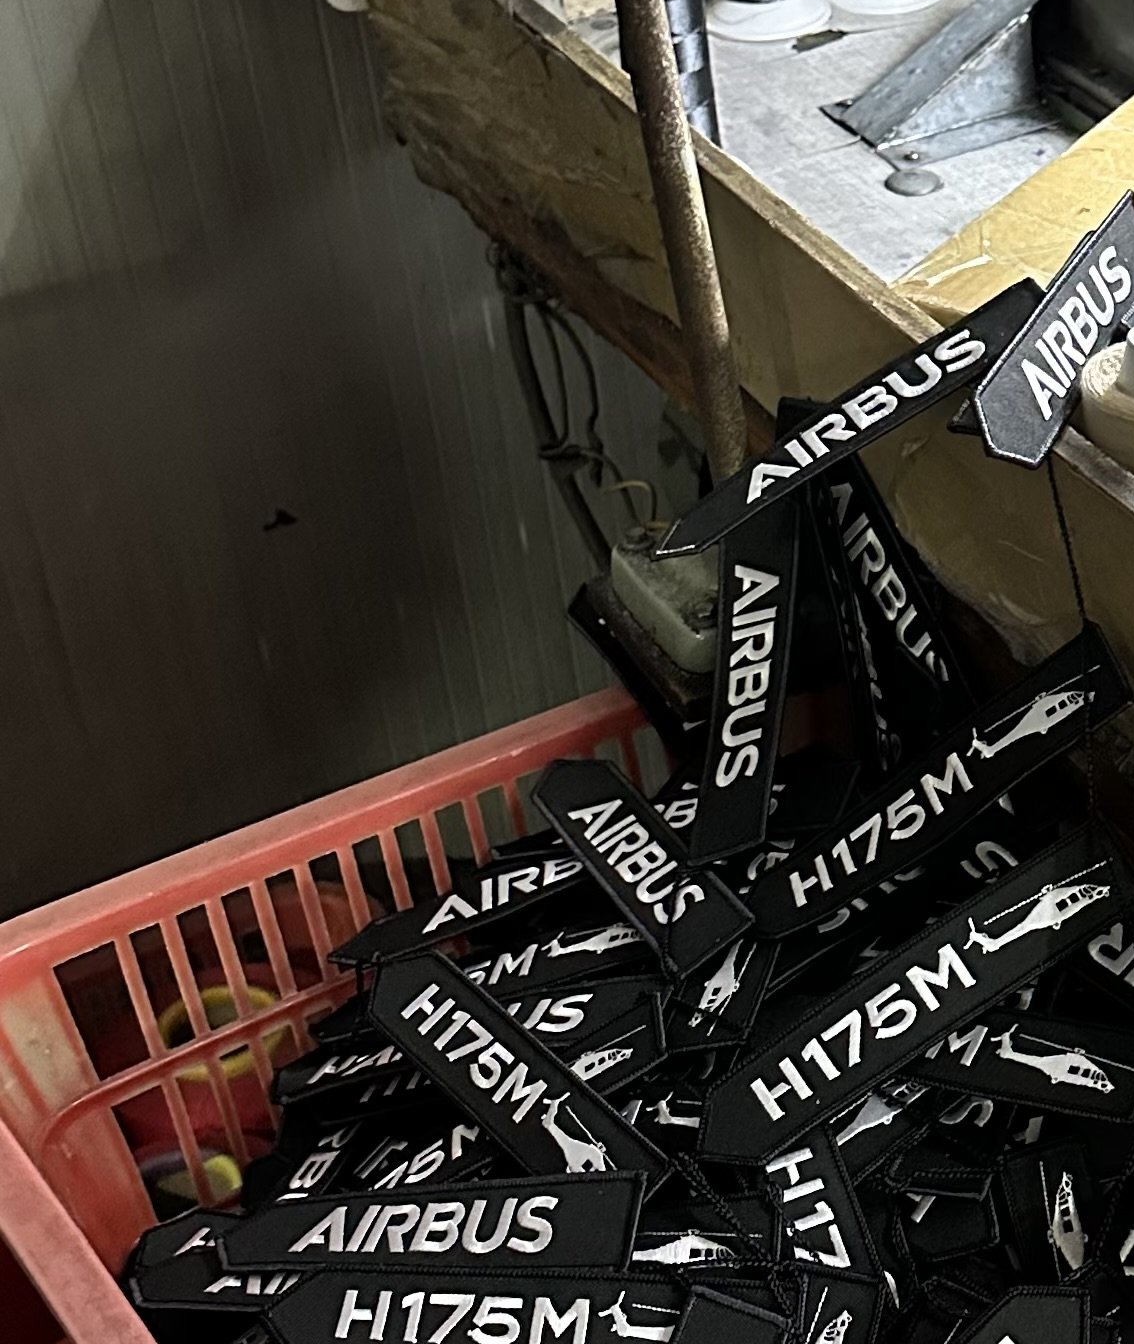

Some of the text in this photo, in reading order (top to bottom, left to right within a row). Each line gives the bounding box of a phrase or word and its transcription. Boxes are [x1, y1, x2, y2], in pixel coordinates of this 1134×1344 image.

[1019, 246, 1132, 421] AIRBUS
[745, 328, 986, 504] AIRBUS
[714, 563, 780, 789] AIRBUS
[421, 856, 585, 935] AIRB
[567, 798, 706, 925] AIRBUS
[788, 752, 974, 908] H175M
[400, 982, 549, 1124] H175M
[749, 943, 976, 1122] H175M
[288, 1195, 559, 1254] AIRBUS
[765, 1146, 852, 1269] H17
